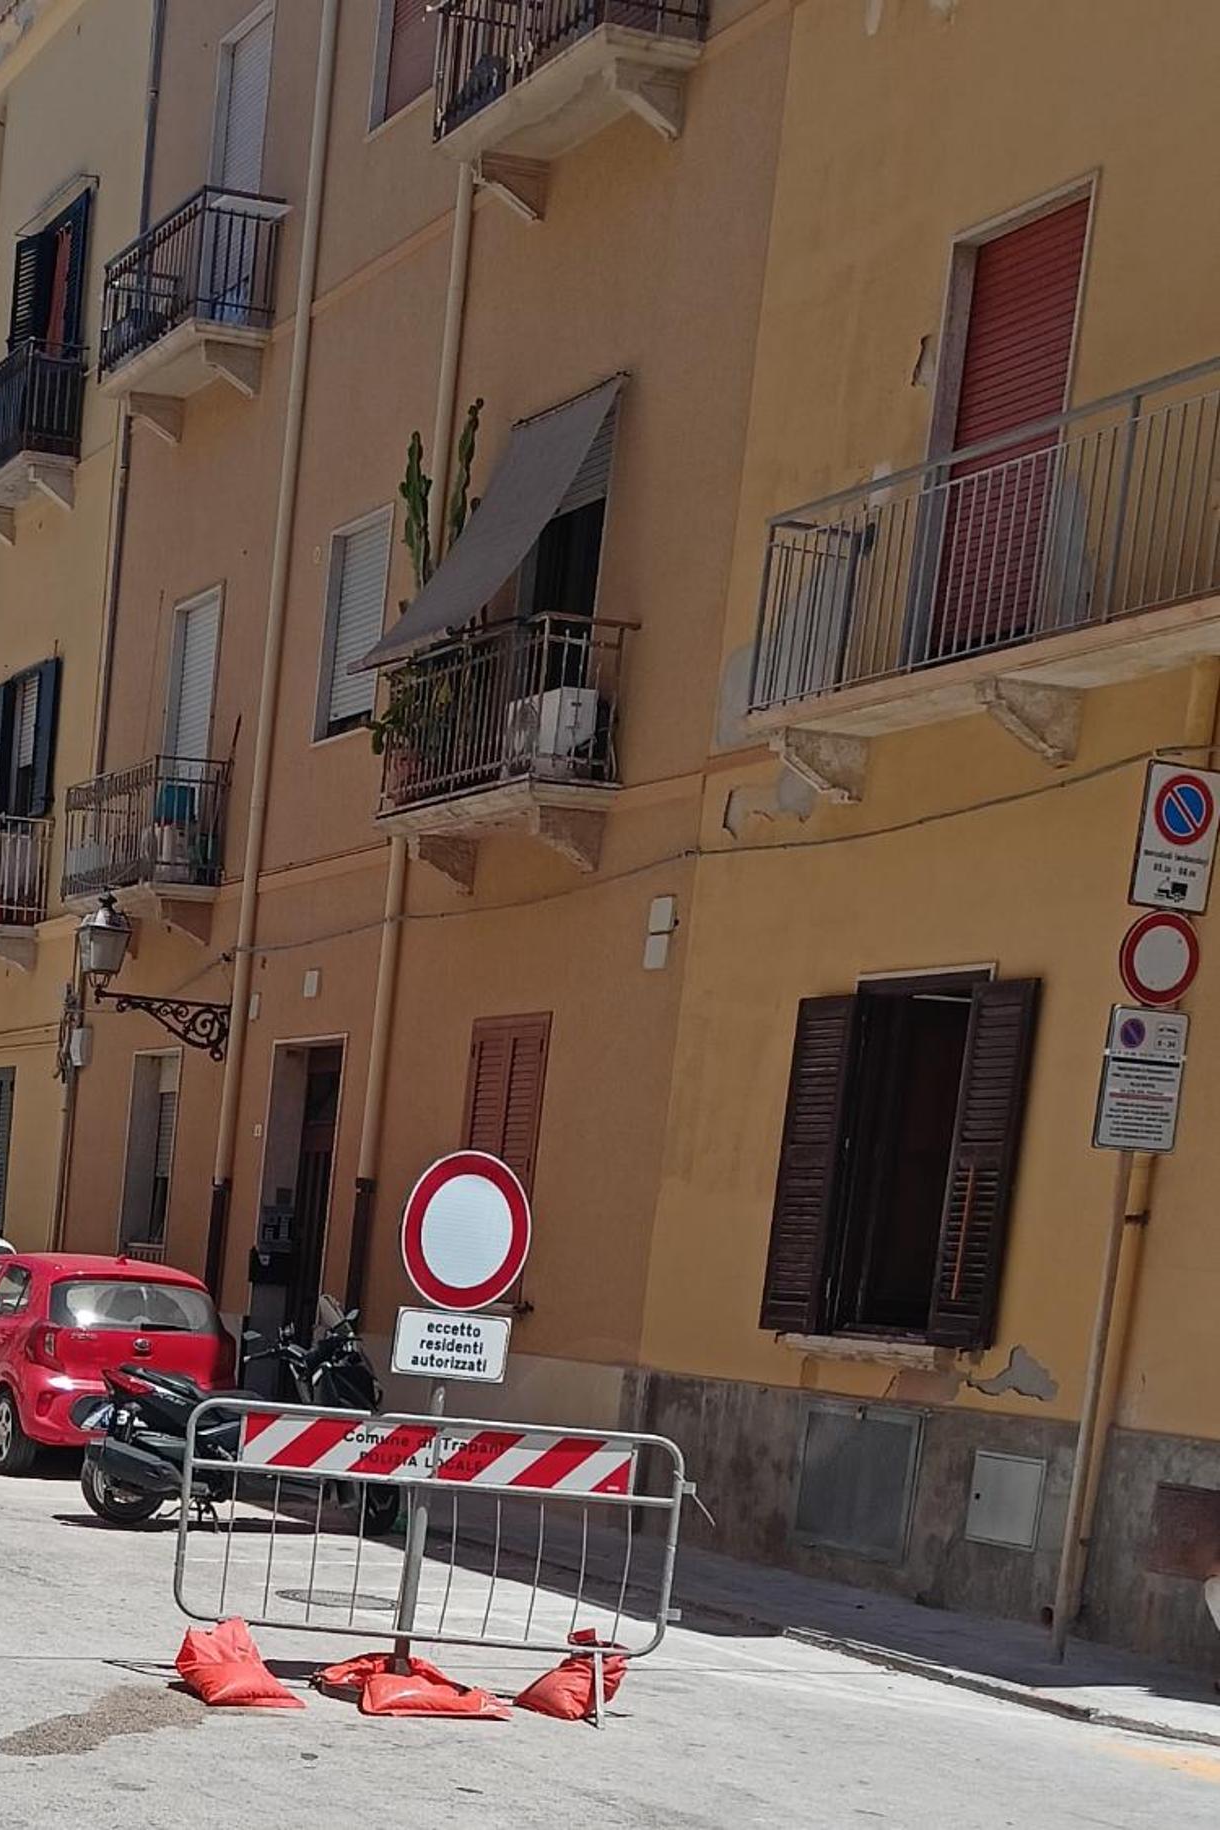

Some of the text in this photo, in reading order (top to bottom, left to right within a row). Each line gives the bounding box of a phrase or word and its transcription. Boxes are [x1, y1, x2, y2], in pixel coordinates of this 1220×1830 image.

[427, 1322, 481, 1338] eccetto
[420, 1338, 484, 1355] residenti
[411, 1354, 487, 1373] autorizzati
[343, 1430, 504, 1453] Comune di Trapani
[359, 1451, 417, 1467] POLIZIA
